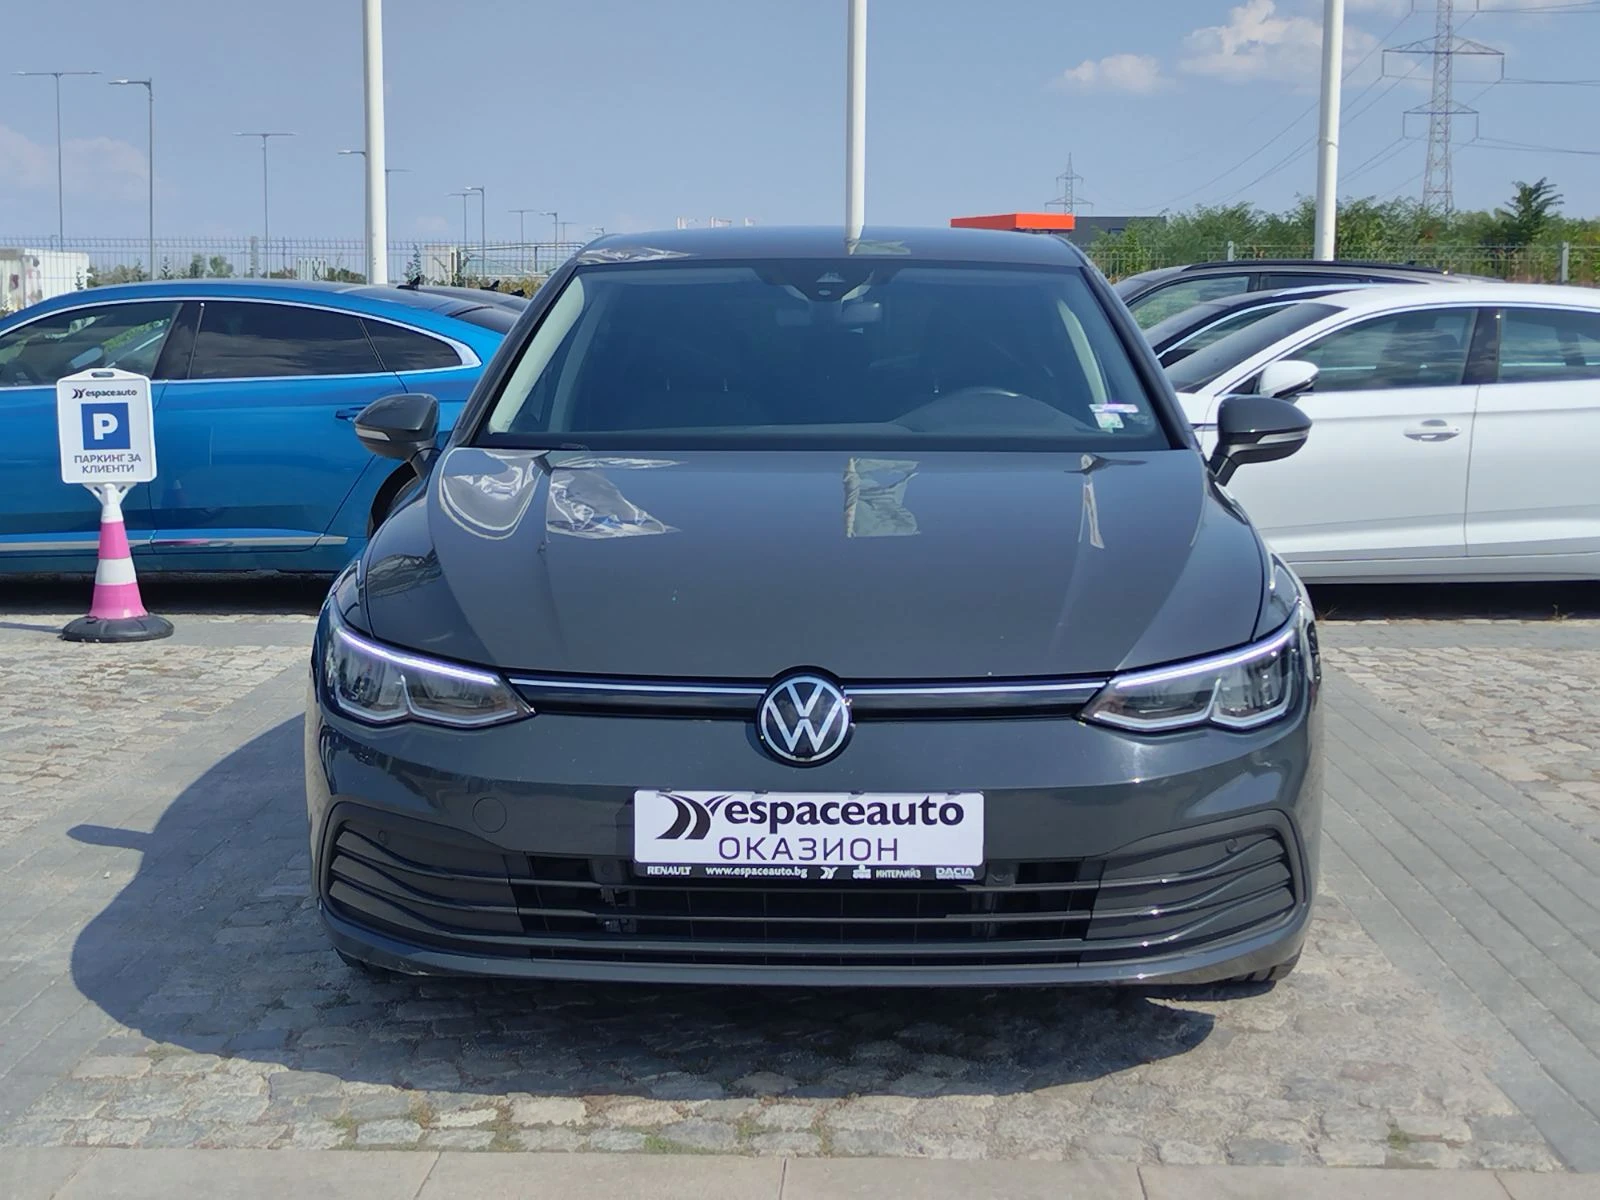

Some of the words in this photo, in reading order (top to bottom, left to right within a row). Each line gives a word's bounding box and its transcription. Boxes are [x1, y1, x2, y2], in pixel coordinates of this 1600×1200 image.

[86, 389, 137, 398] espaceauto
[93, 413, 118, 440] P
[74, 453, 125, 464] ПАРКИНГ
[127, 453, 142, 463] ЗА
[82, 464, 135, 474] КЛИЕНТИ
[724, 795, 965, 835] espaceauto
[718, 836, 899, 862] ОКАЗИОН
[647, 866, 691, 876] RENAULT
[705, 866, 808, 878] www.espaceauto.bg
[935, 867, 974, 878] DACIA
